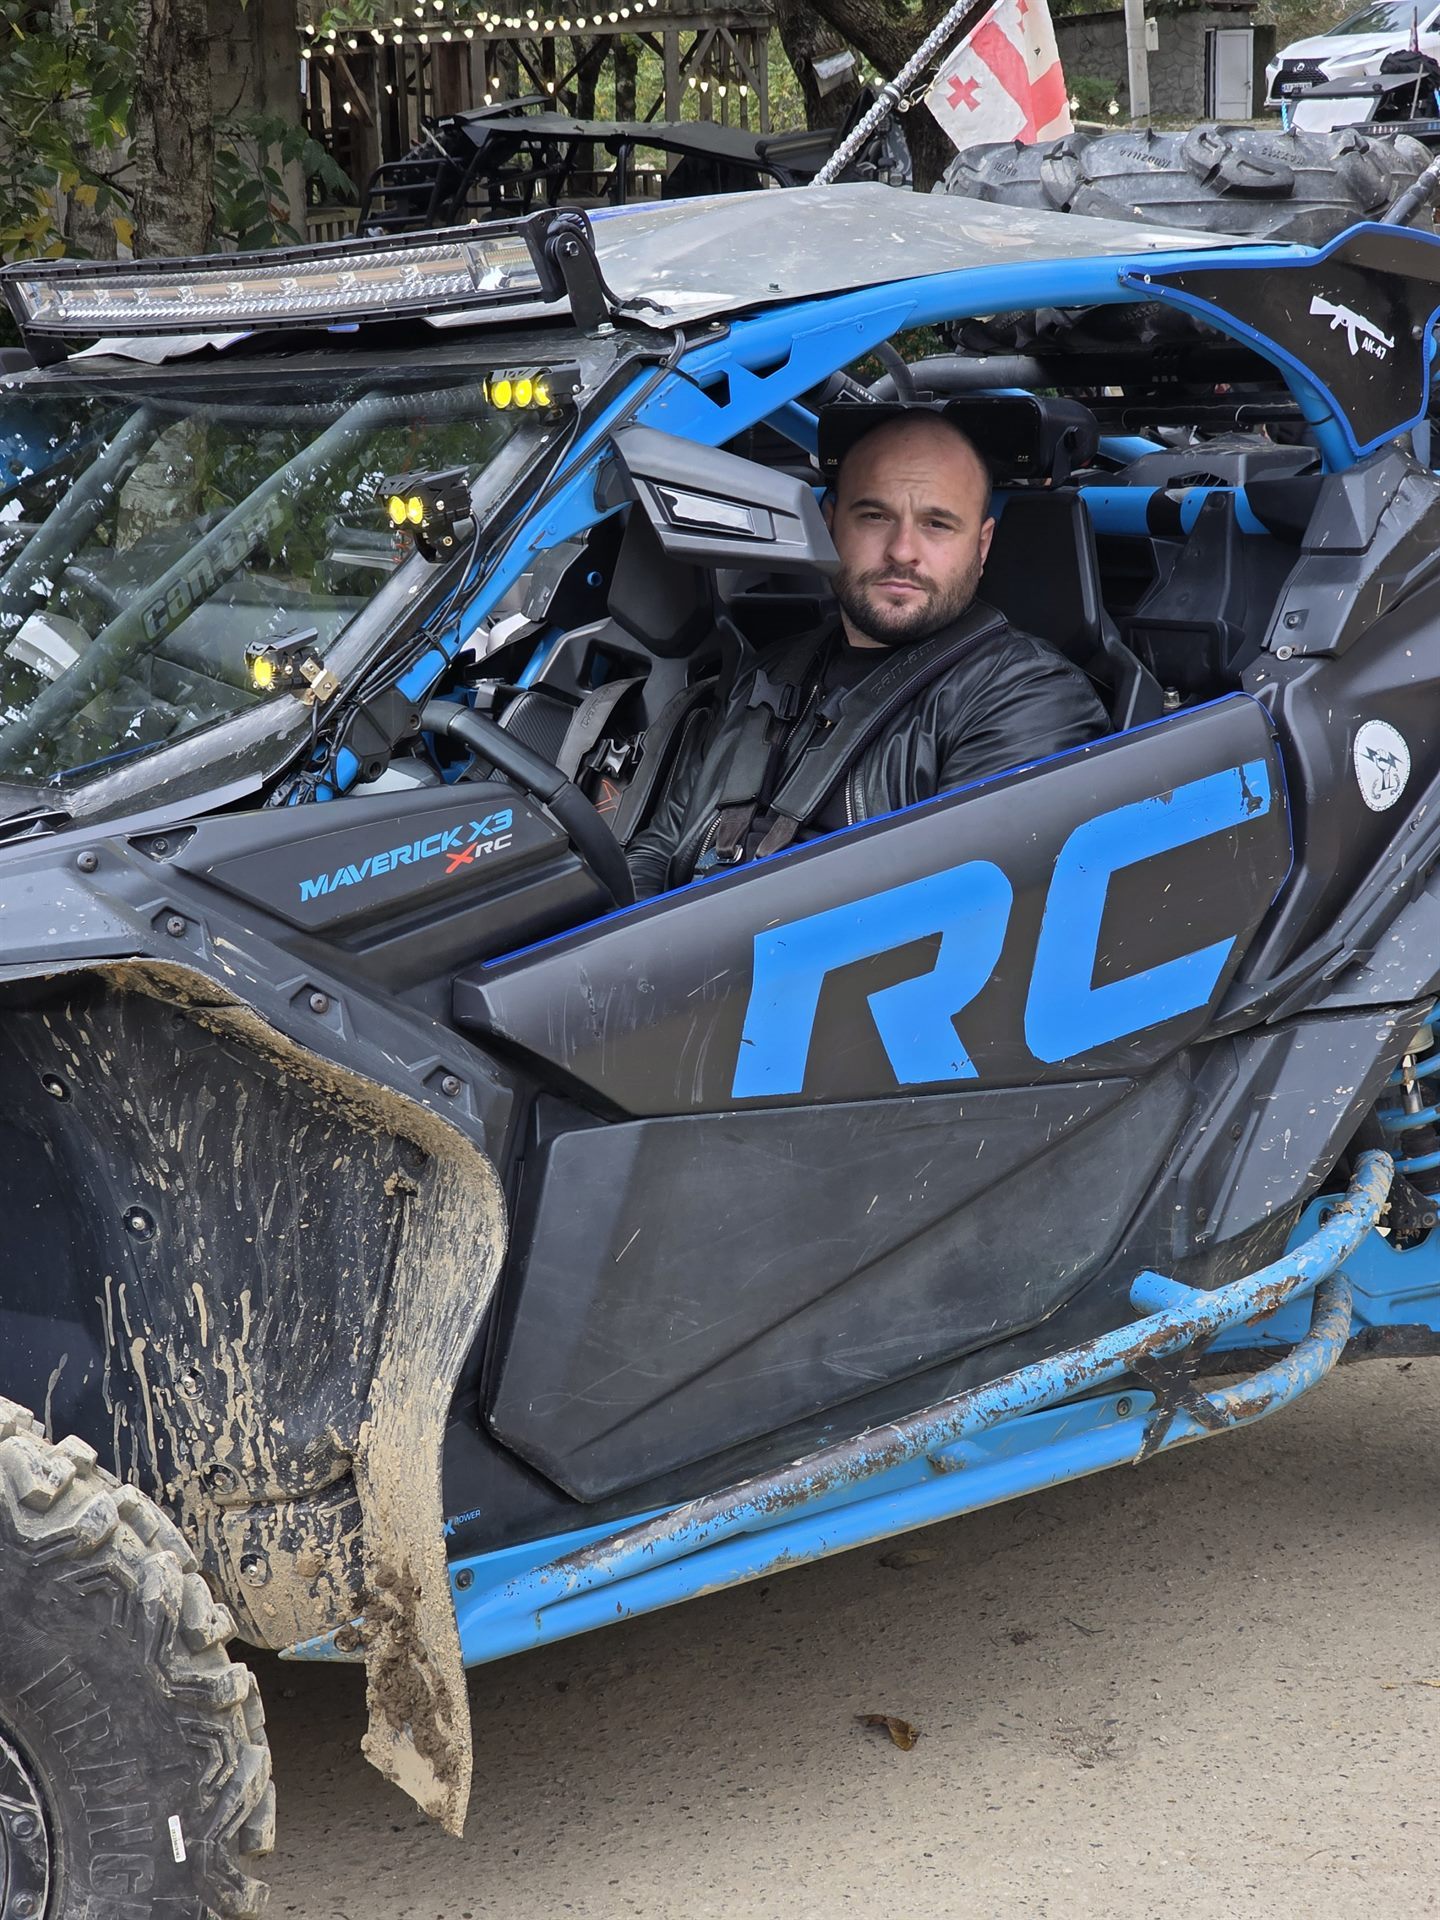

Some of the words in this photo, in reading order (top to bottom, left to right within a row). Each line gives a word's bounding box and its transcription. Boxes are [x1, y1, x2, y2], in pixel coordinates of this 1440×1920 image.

[1361, 336, 1387, 360] AK-47
[298, 825, 464, 903] MAVERICK
[467, 808, 513, 843] X3
[731, 758, 1271, 1099] RC
